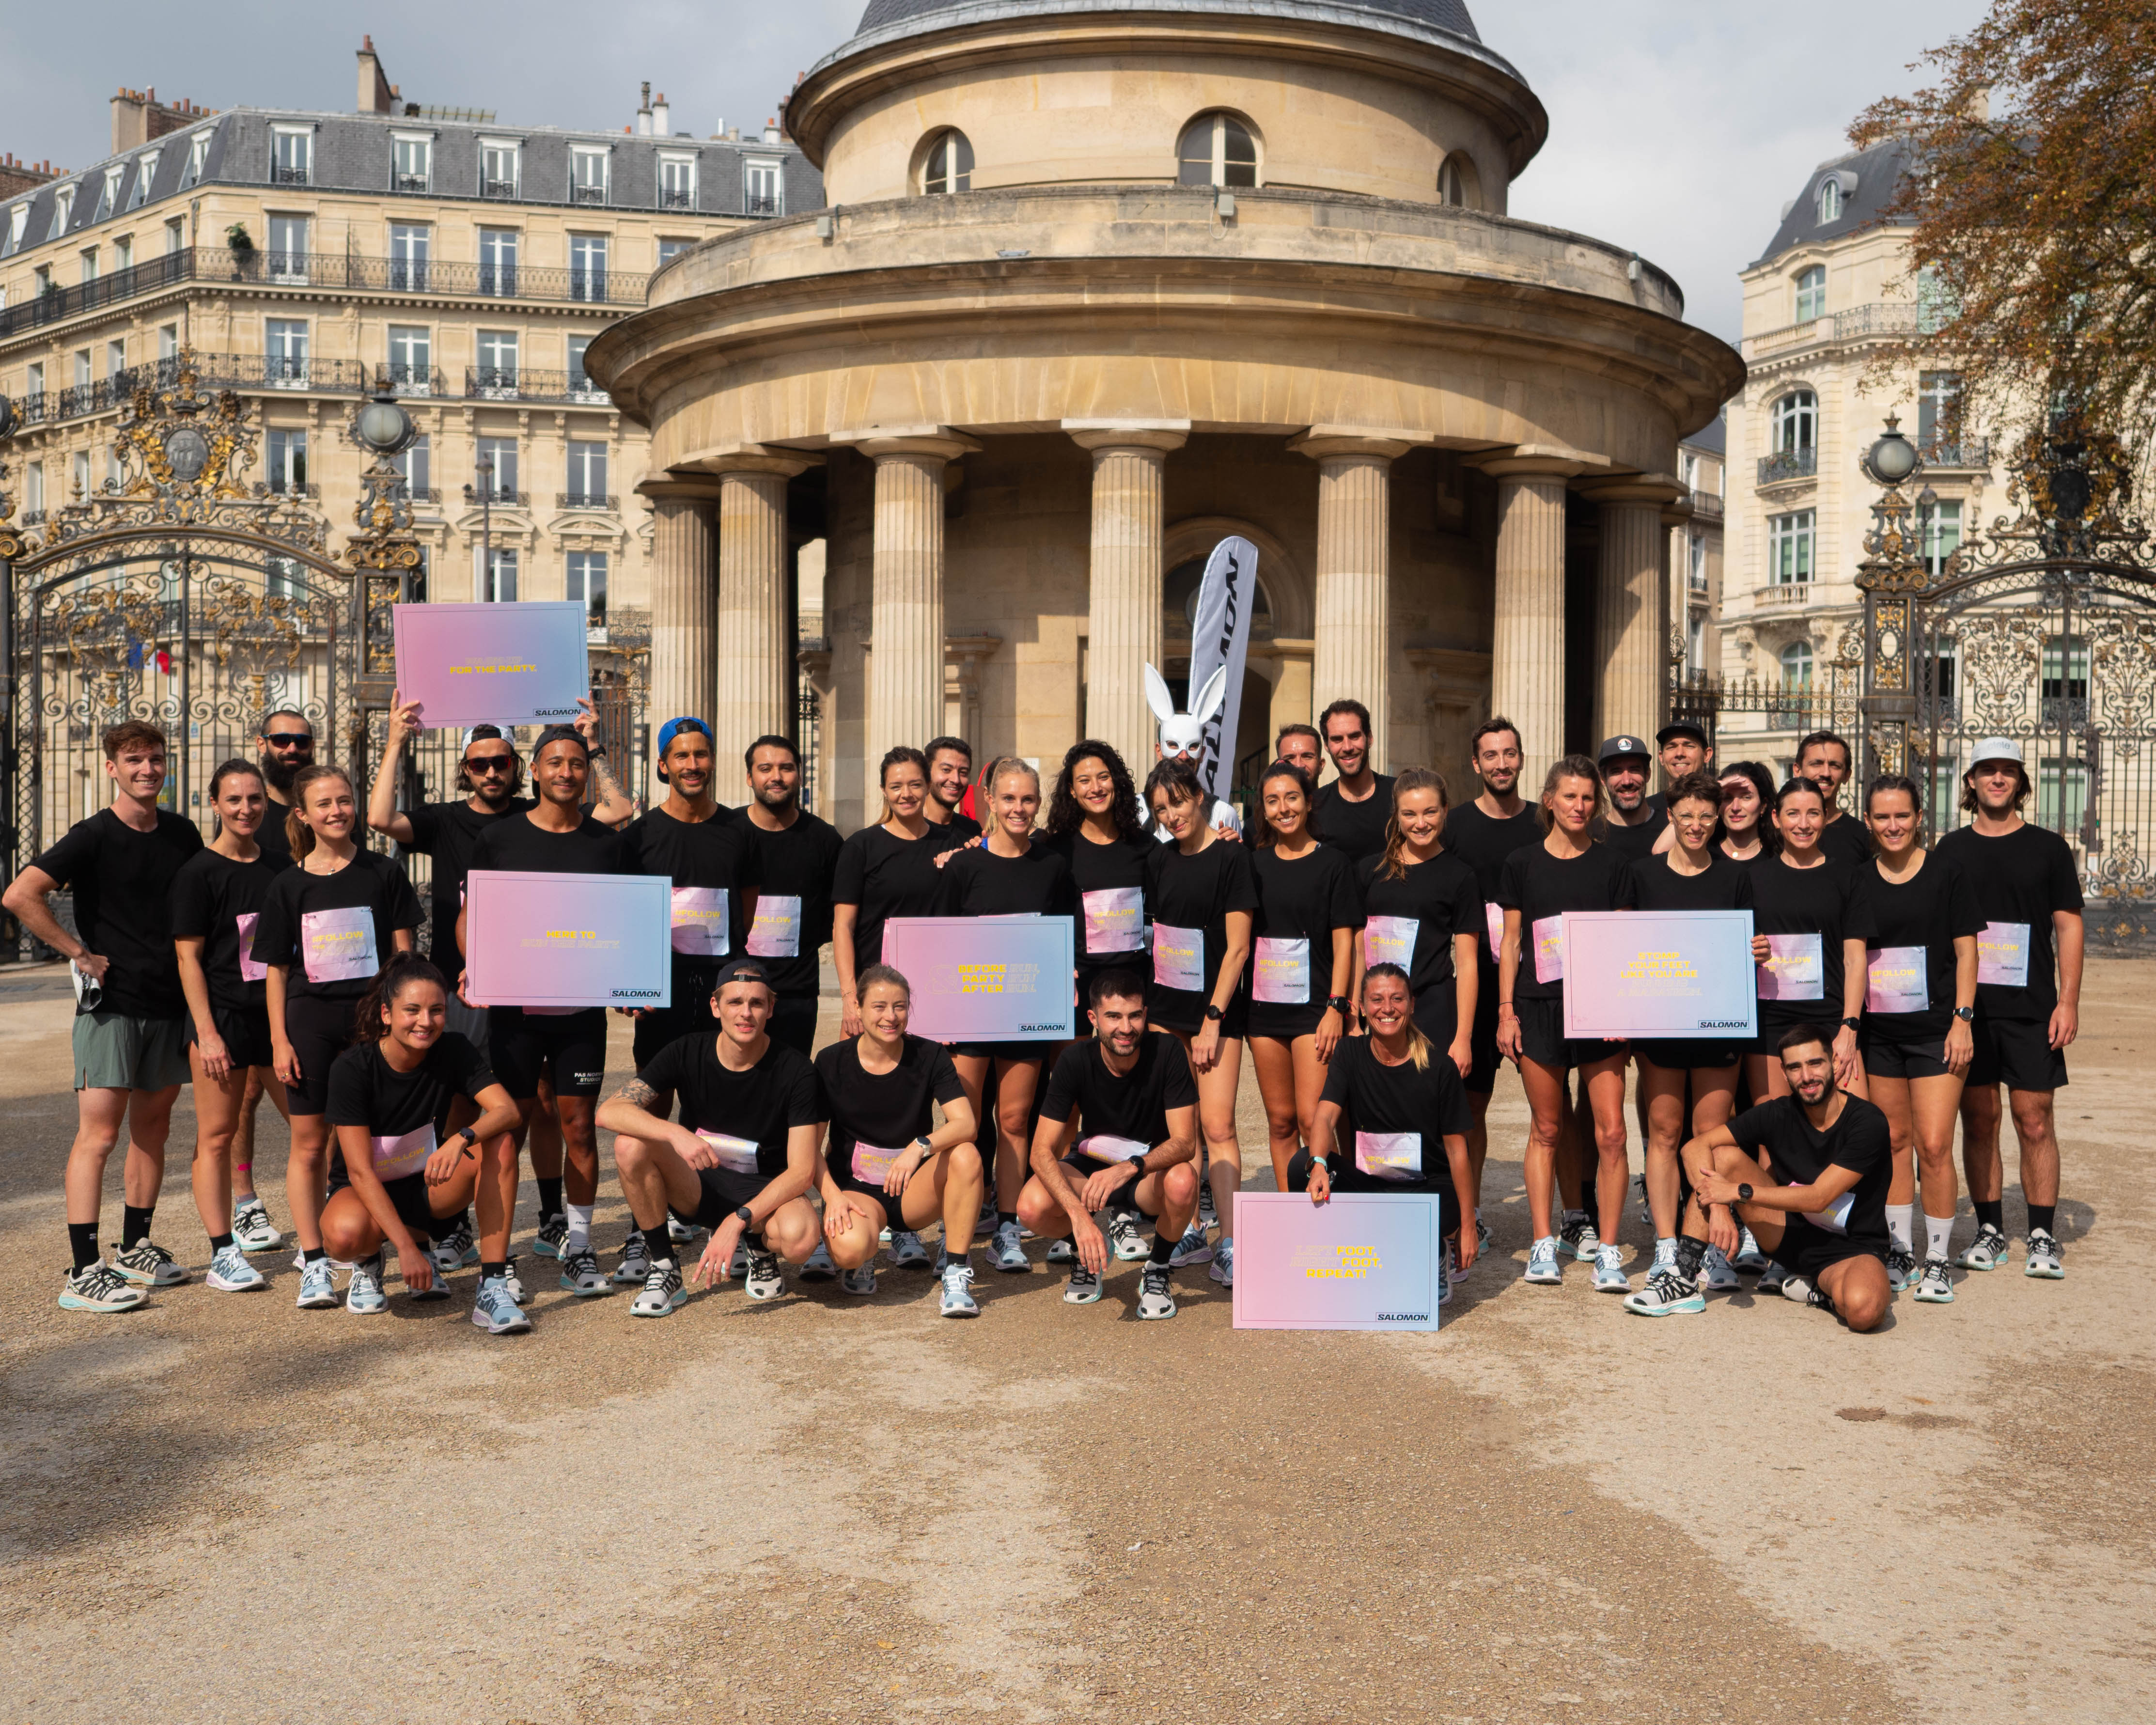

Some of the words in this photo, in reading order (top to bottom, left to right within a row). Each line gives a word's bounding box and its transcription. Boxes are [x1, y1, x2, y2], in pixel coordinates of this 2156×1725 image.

[498, 664, 537, 673] PARTY.
[1204, 551, 1238, 800] ALOON
[534, 708, 581, 717] SALOMON
[675, 910, 720, 918] #FOLLOW
[1094, 908, 1135, 918] #FOLLOW
[312, 930, 363, 943] #FOLLOW
[546, 930, 577, 939] HERE
[579, 930, 596, 939] TO
[1371, 936, 1405, 946] #FOLLOW
[1541, 937, 1563, 947] #FOL
[1158, 945, 1194, 957] #FOLLOW
[1638, 952, 1680, 960] STOMP
[1259, 959, 1299, 968] #FOLLOW
[1627, 961, 1659, 969] YOUR
[1661, 960, 1690, 969] FEET
[958, 964, 1007, 973] BEFORE
[1621, 970, 1646, 978] LIKE
[1871, 969, 1916, 978] #FOLLOW
[962, 974, 1005, 983] PARTY
[962, 985, 1003, 993] AFTER
[376, 1146, 425, 1167] #FOLLOW
[860, 1153, 897, 1164] #FOLLO
[1364, 1156, 1410, 1164] #FOLLOW
[1337, 1245, 1377, 1258] FOOT,
[1342, 1257, 1383, 1270] FOOT,
[1306, 1268, 1367, 1279] REPEAT!
